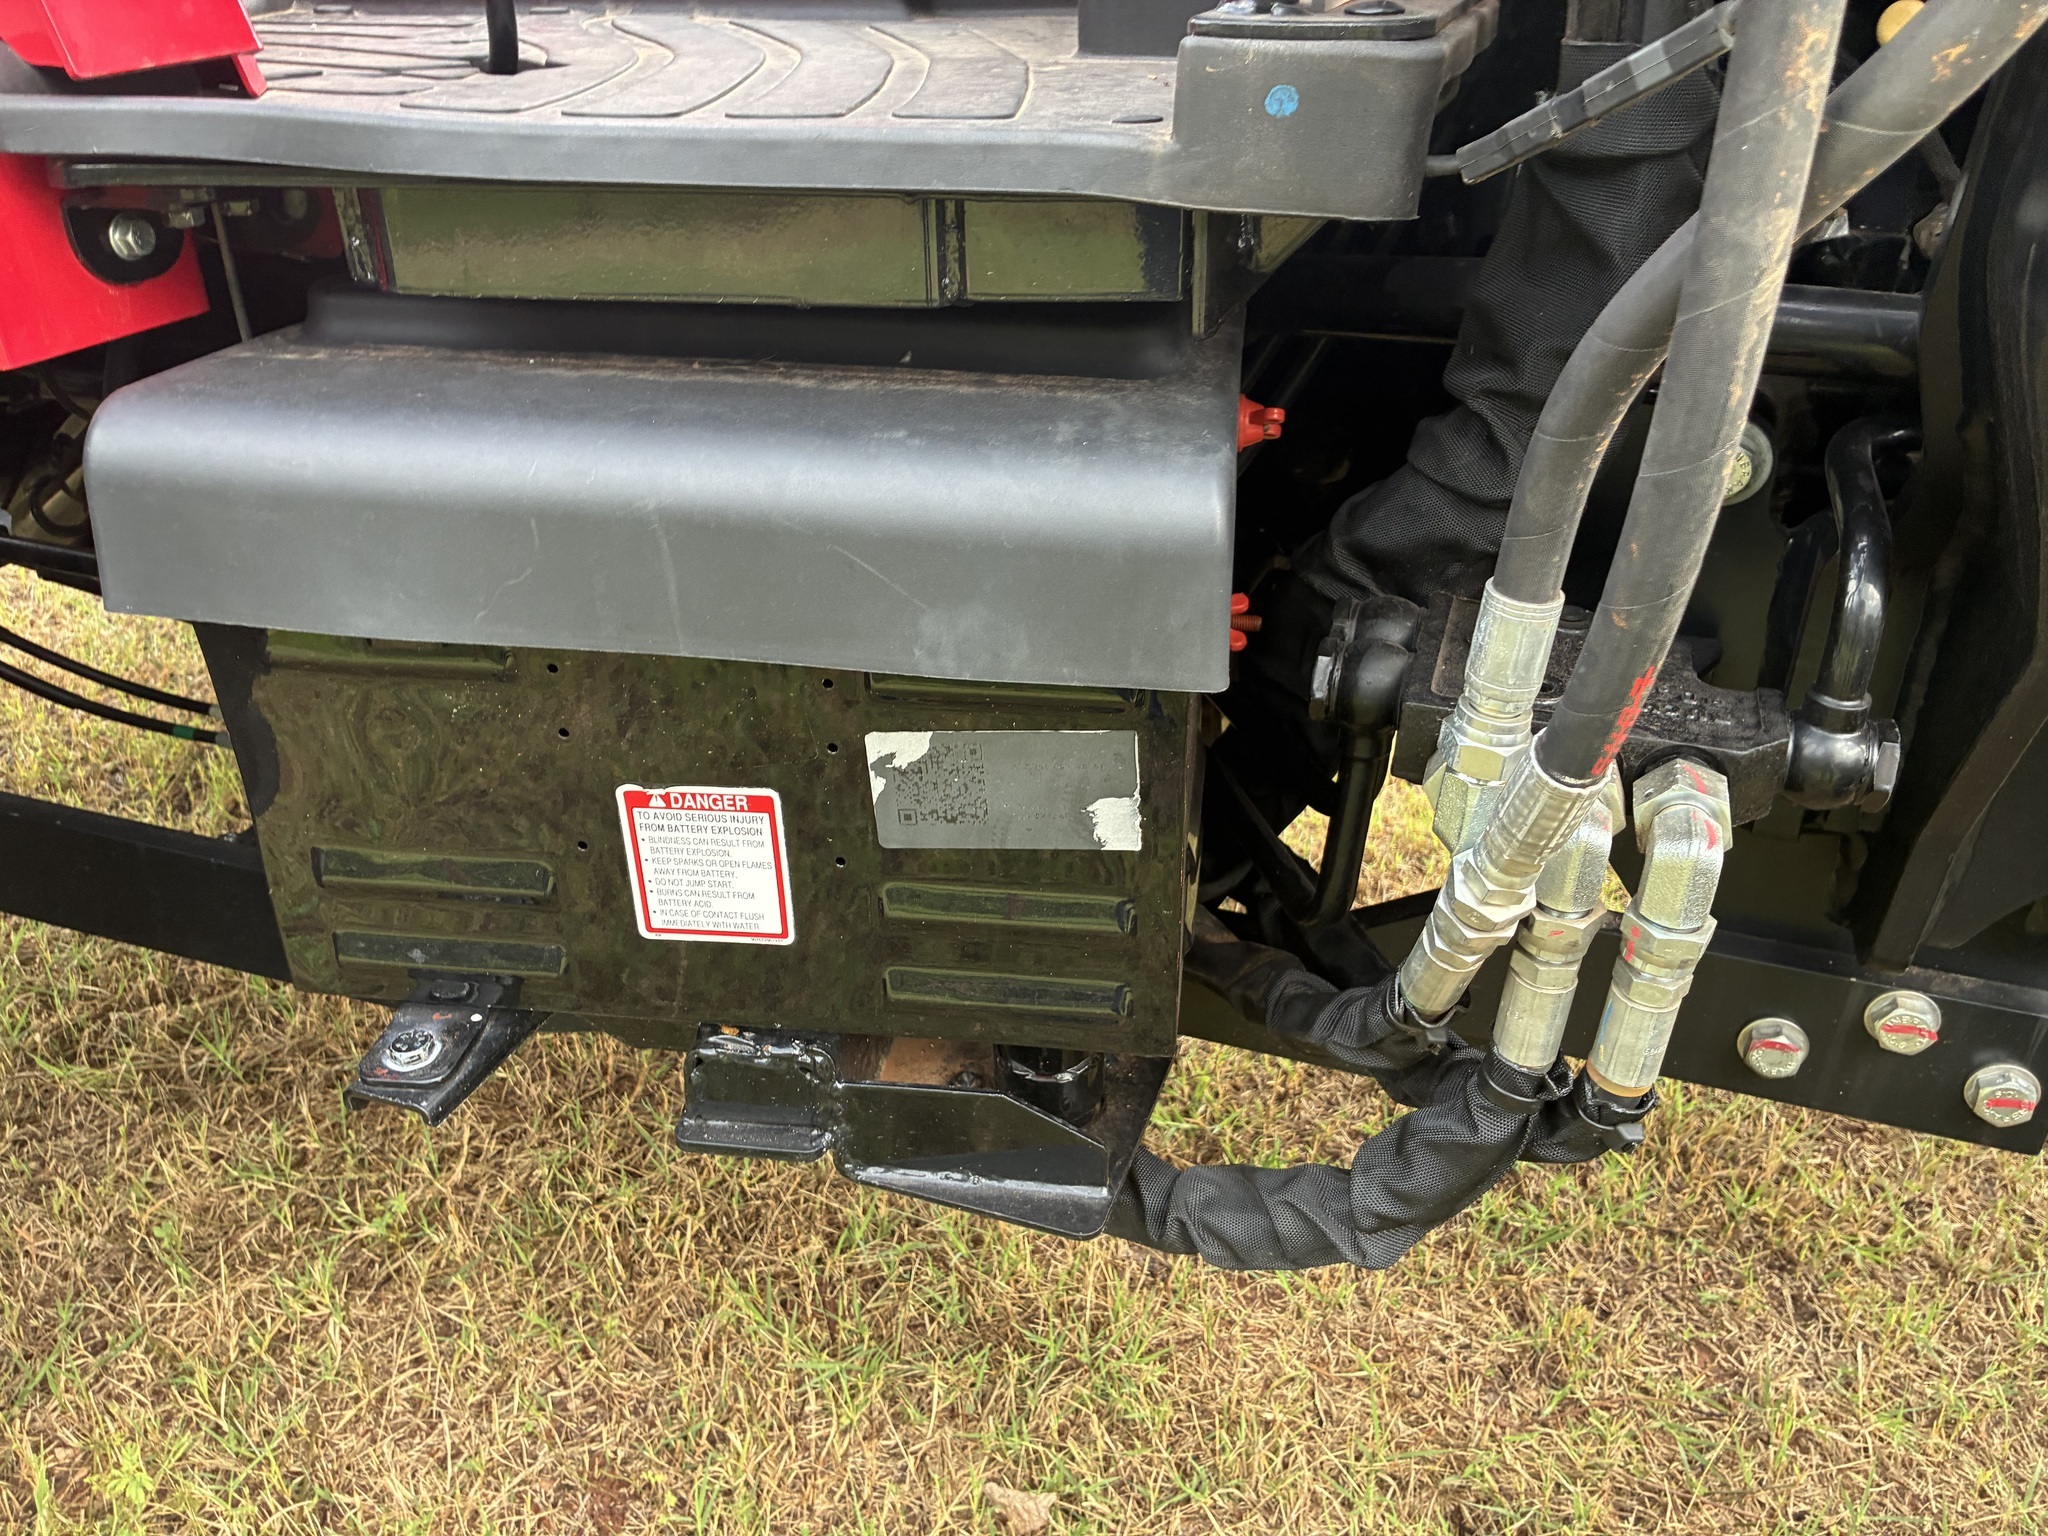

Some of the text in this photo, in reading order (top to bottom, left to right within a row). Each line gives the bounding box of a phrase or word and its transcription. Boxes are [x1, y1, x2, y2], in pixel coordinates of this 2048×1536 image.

[670, 793, 748, 810] DANGER
[637, 811, 764, 825] TO AVOID SERIOUS INJURY
[639, 823, 762, 836] FROM BATTERY EXPLOSION
[649, 836, 690, 845] BLINDNESS
[711, 839, 740, 847] RESULT
[650, 847, 732, 857] BATTERY EXPLOSION.
[674, 858, 703, 866] SPARKS
[719, 860, 740, 868] OPEN
[677, 868, 699, 876] FROM
[701, 870, 737, 878] BATTERY.
[657, 888, 682, 896] BURNS
[658, 899, 713, 908] BATTERY ACID.
[691, 910, 701, 918] OF
[703, 911, 738, 919] CONTACT
[662, 920, 759, 930] IMMEDIATELY WITH WATER
